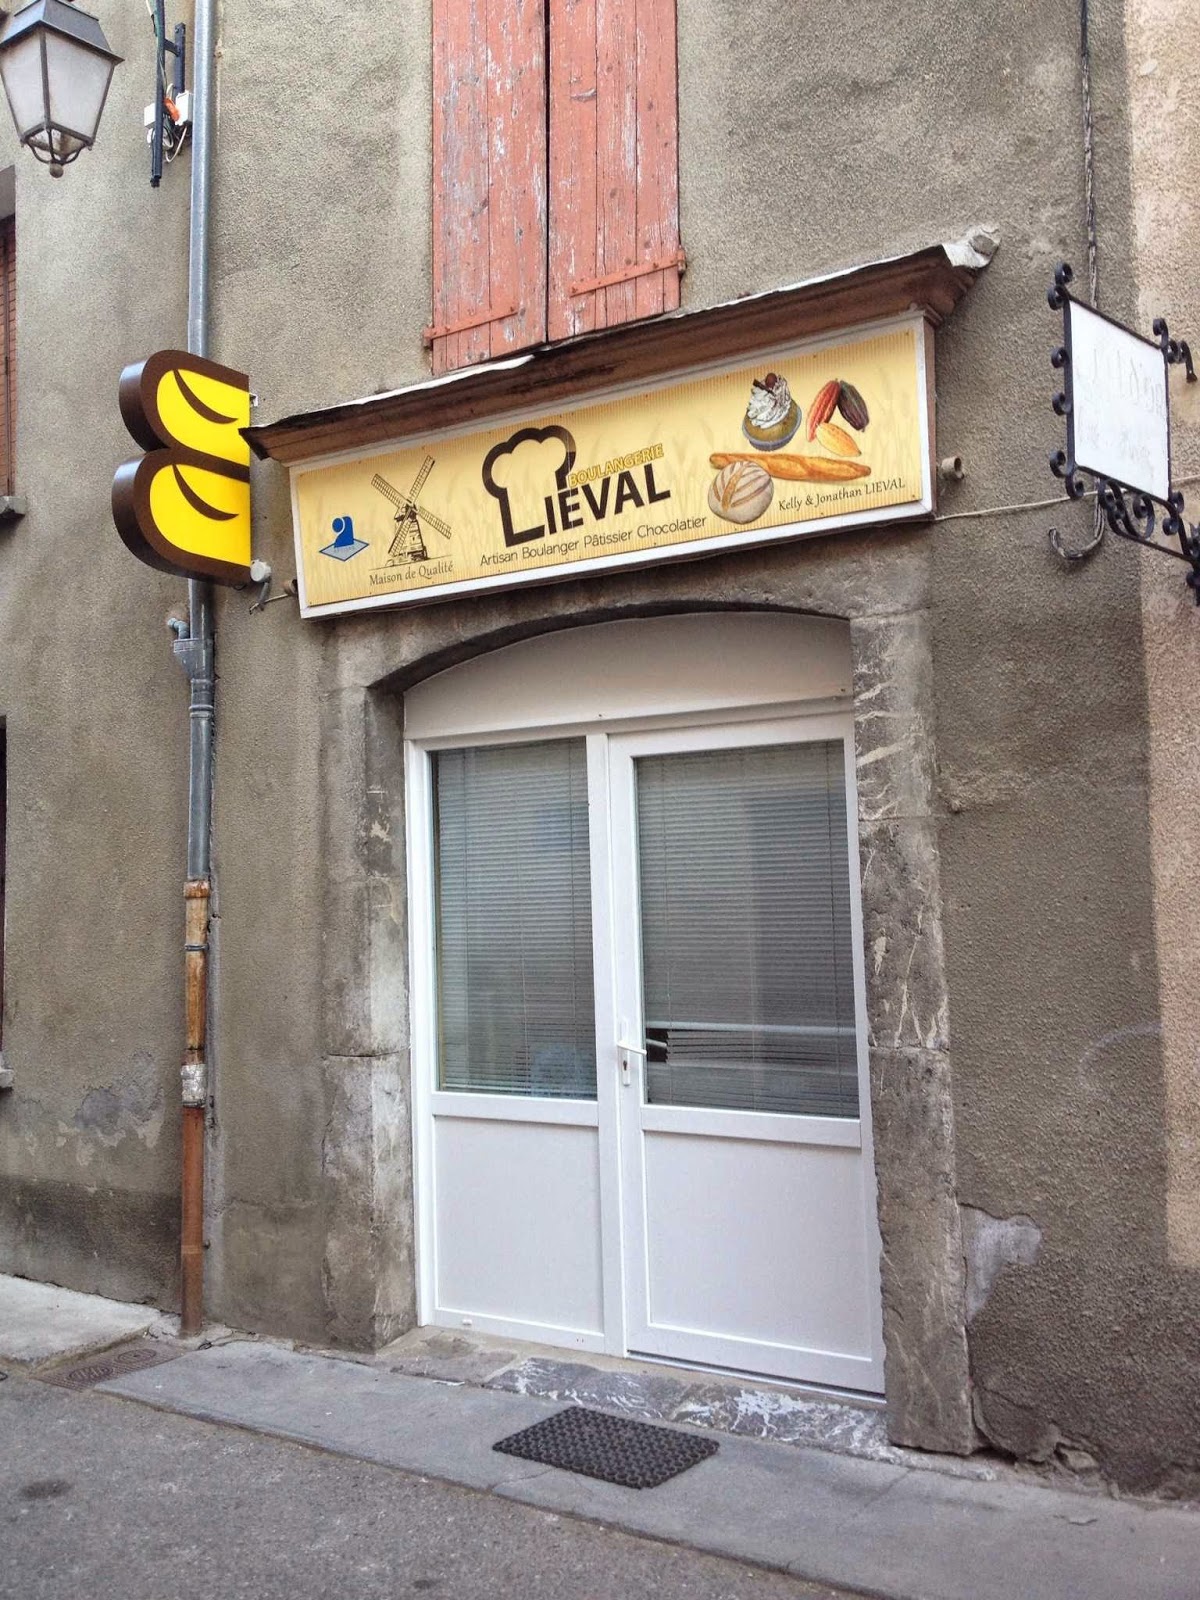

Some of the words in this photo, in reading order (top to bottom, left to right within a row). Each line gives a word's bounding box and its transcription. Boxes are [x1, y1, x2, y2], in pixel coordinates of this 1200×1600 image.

[567, 443, 665, 488] BOULANGERIE
[498, 463, 671, 548] LIEVAL
[778, 496, 803, 512] Kelly
[805, 495, 814, 506] &
[814, 487, 862, 508] Jonathan
[864, 477, 906, 495] LIEVAL
[480, 551, 518, 566] Artisan
[522, 540, 580, 560] Boulanger
[583, 529, 633, 549] Pâtissier
[637, 516, 707, 539] Chocolatier
[369, 572, 403, 586] Maison
[405, 566, 417, 580] de
[418, 560, 454, 580] Qualité
